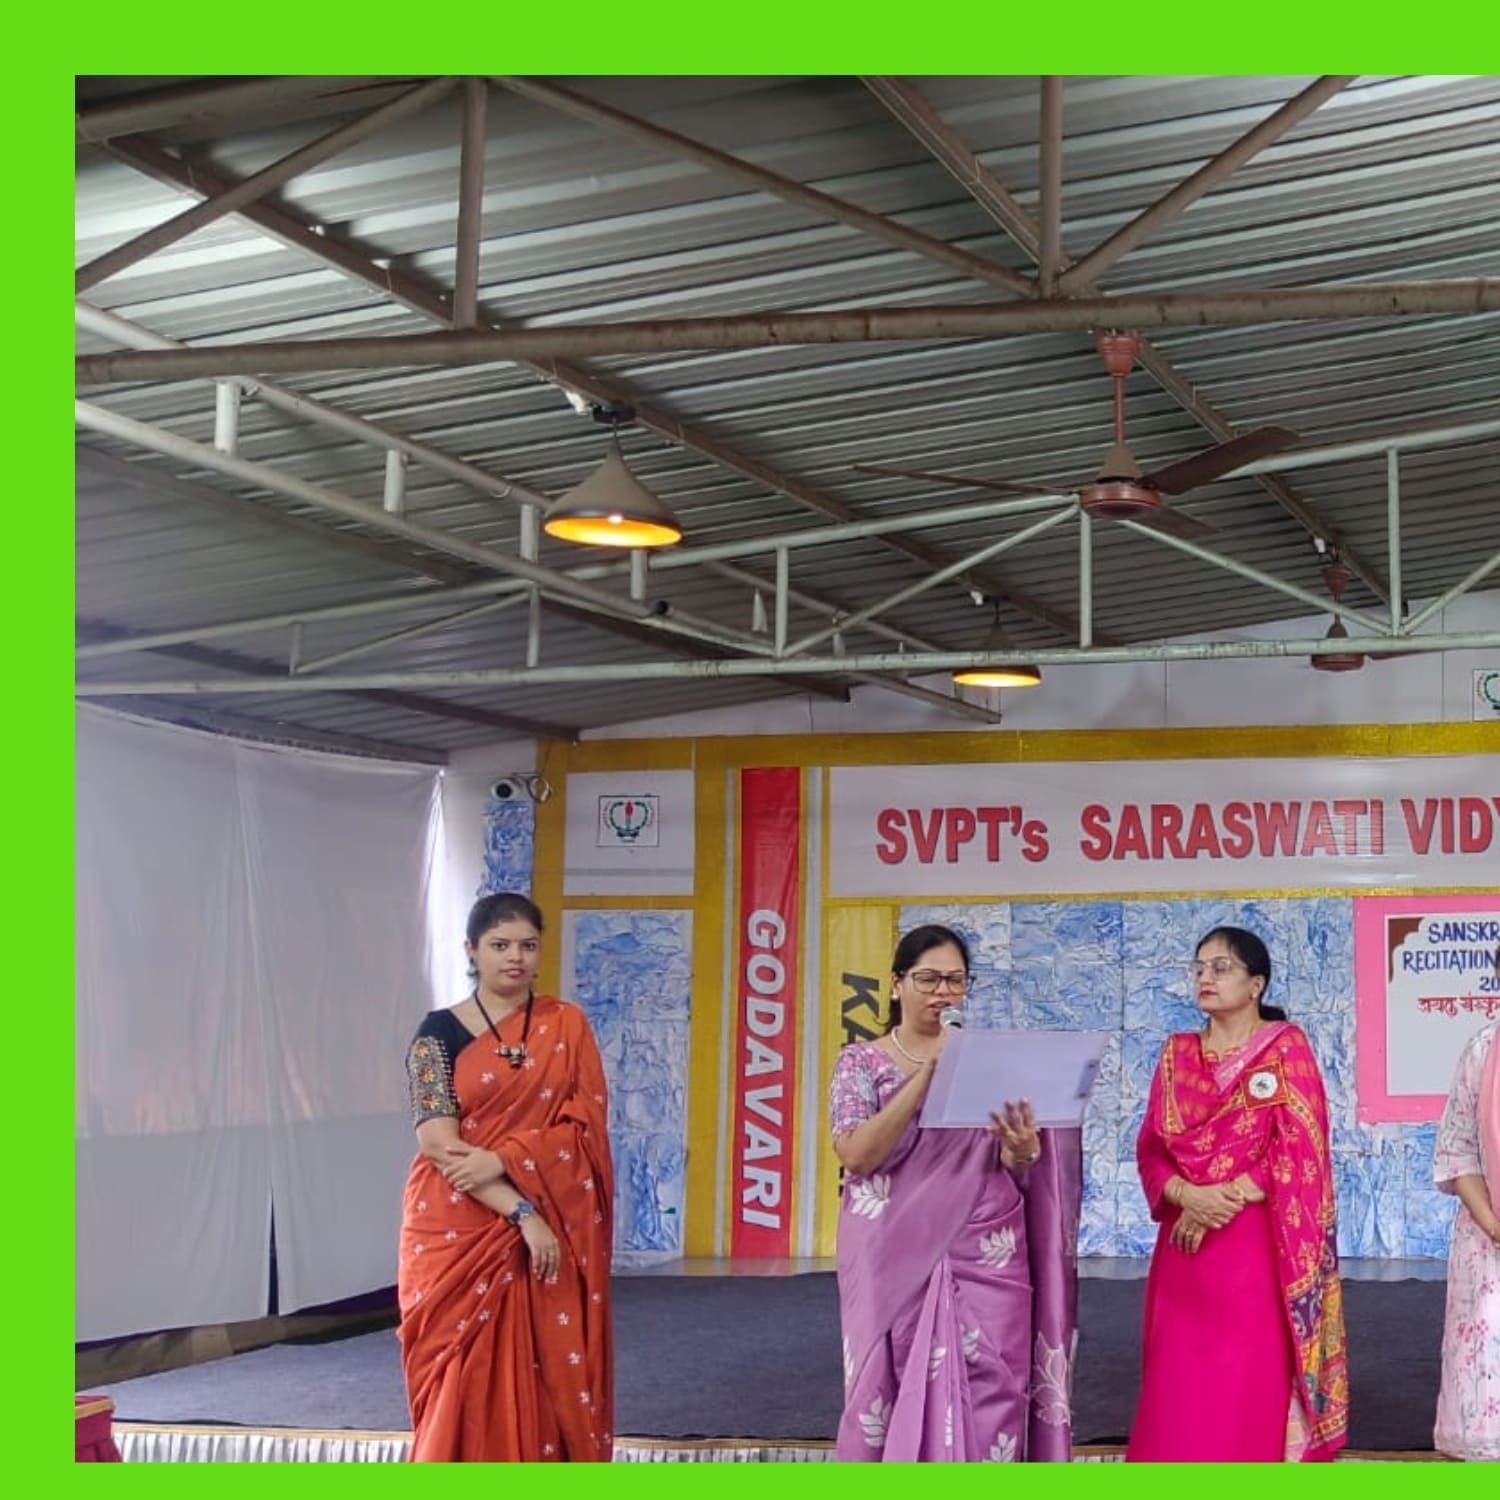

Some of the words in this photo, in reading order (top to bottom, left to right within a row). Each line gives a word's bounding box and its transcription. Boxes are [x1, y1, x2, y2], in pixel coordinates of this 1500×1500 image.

[1080, 800, 1385, 861] SARASWATI
[1403, 948, 1497, 975] RECITATION
[743, 908, 787, 1229] GODAVARI
